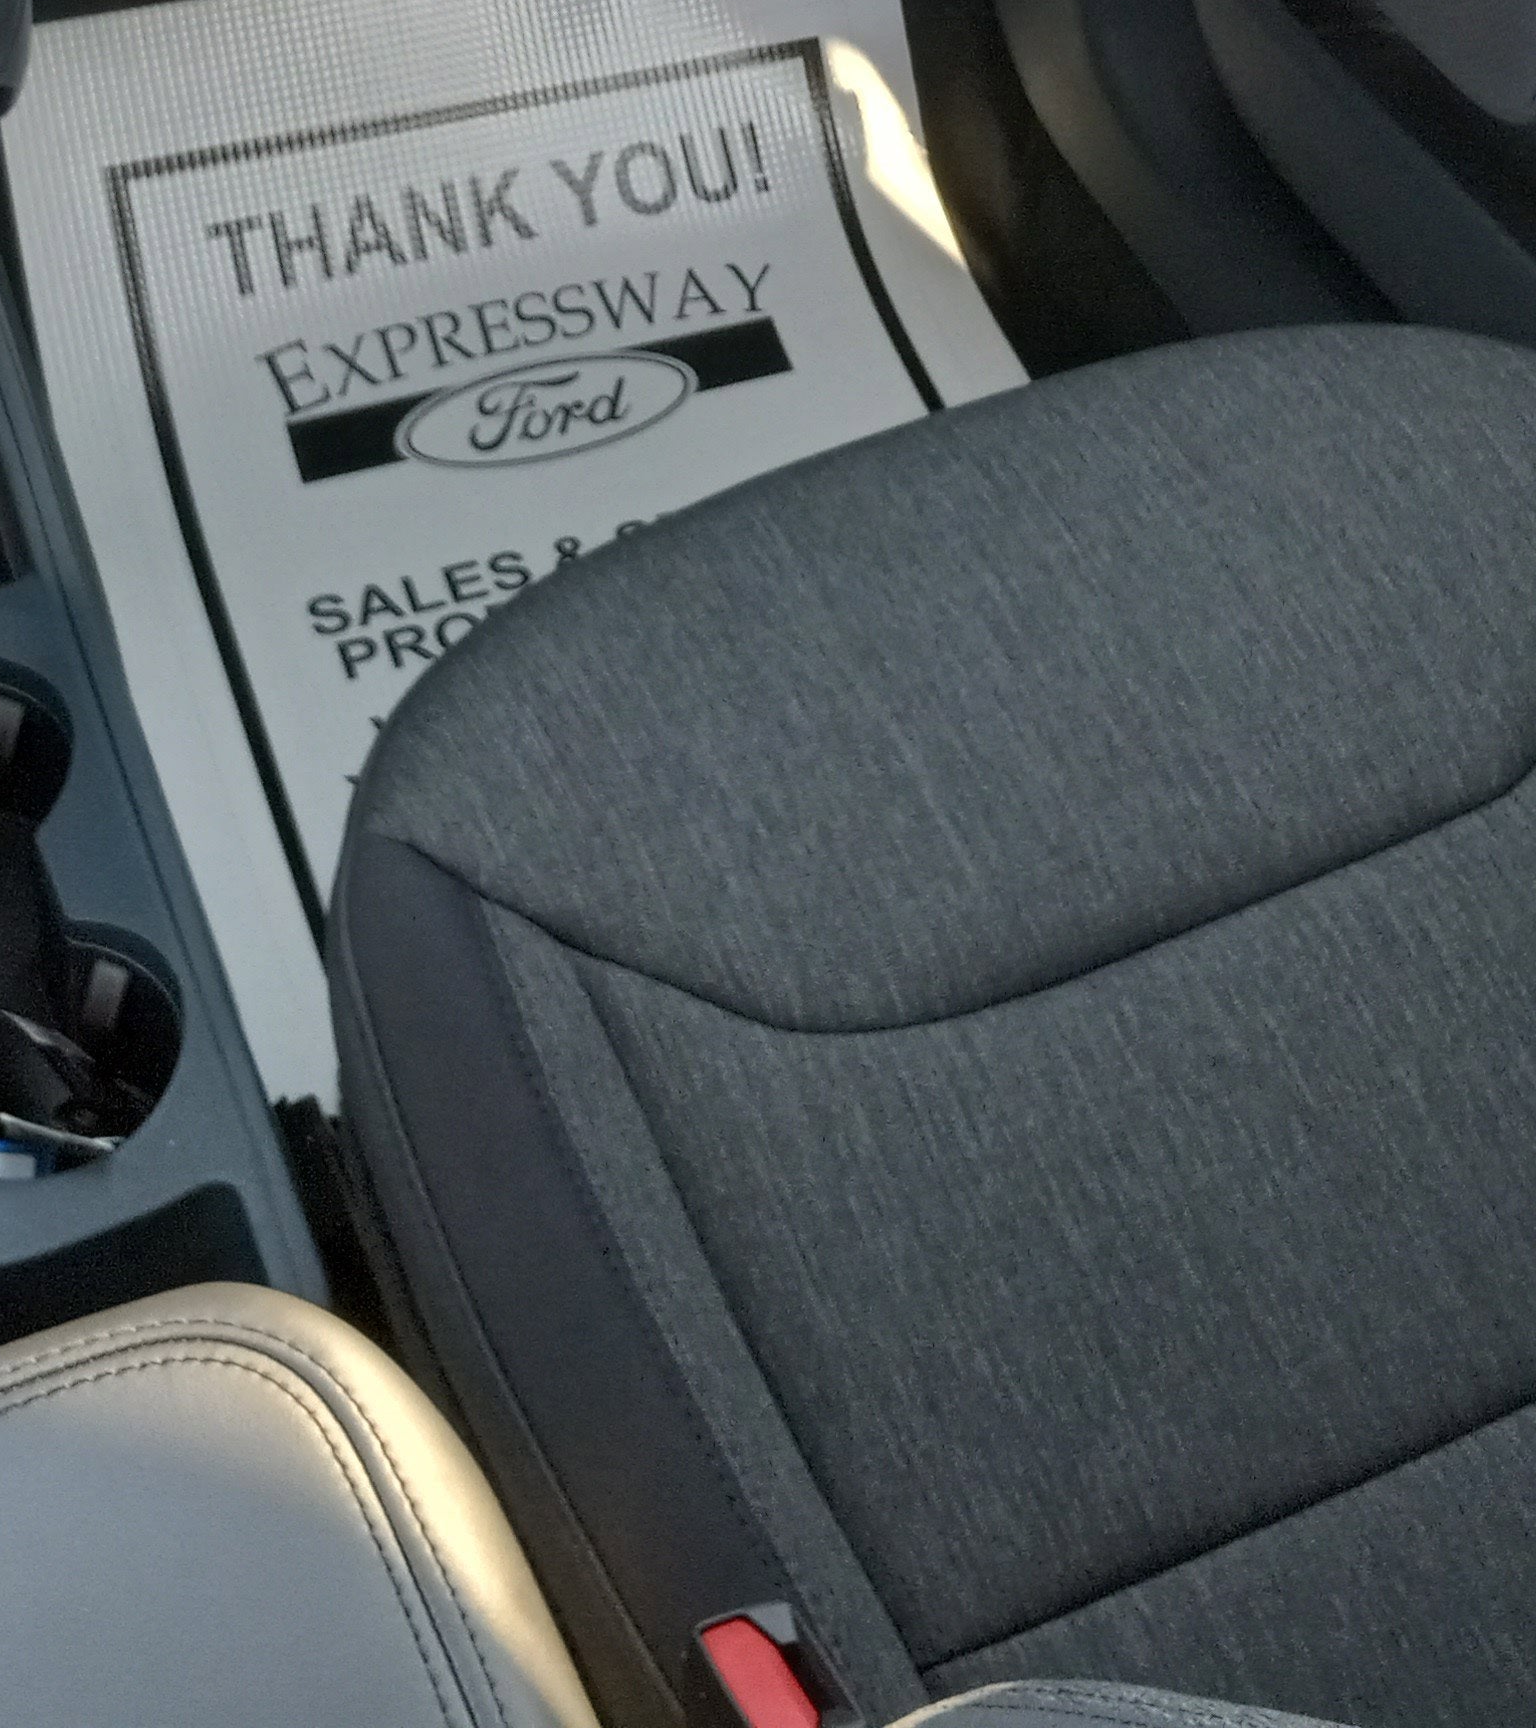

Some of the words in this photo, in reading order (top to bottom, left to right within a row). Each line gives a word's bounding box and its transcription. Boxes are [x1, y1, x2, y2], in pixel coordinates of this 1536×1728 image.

[207, 165, 539, 295] THANK
[551, 120, 774, 228] YOU!
[257, 263, 773, 415] EXPRESSWAY
[468, 370, 632, 454] Ford
[307, 550, 532, 635] SALES
